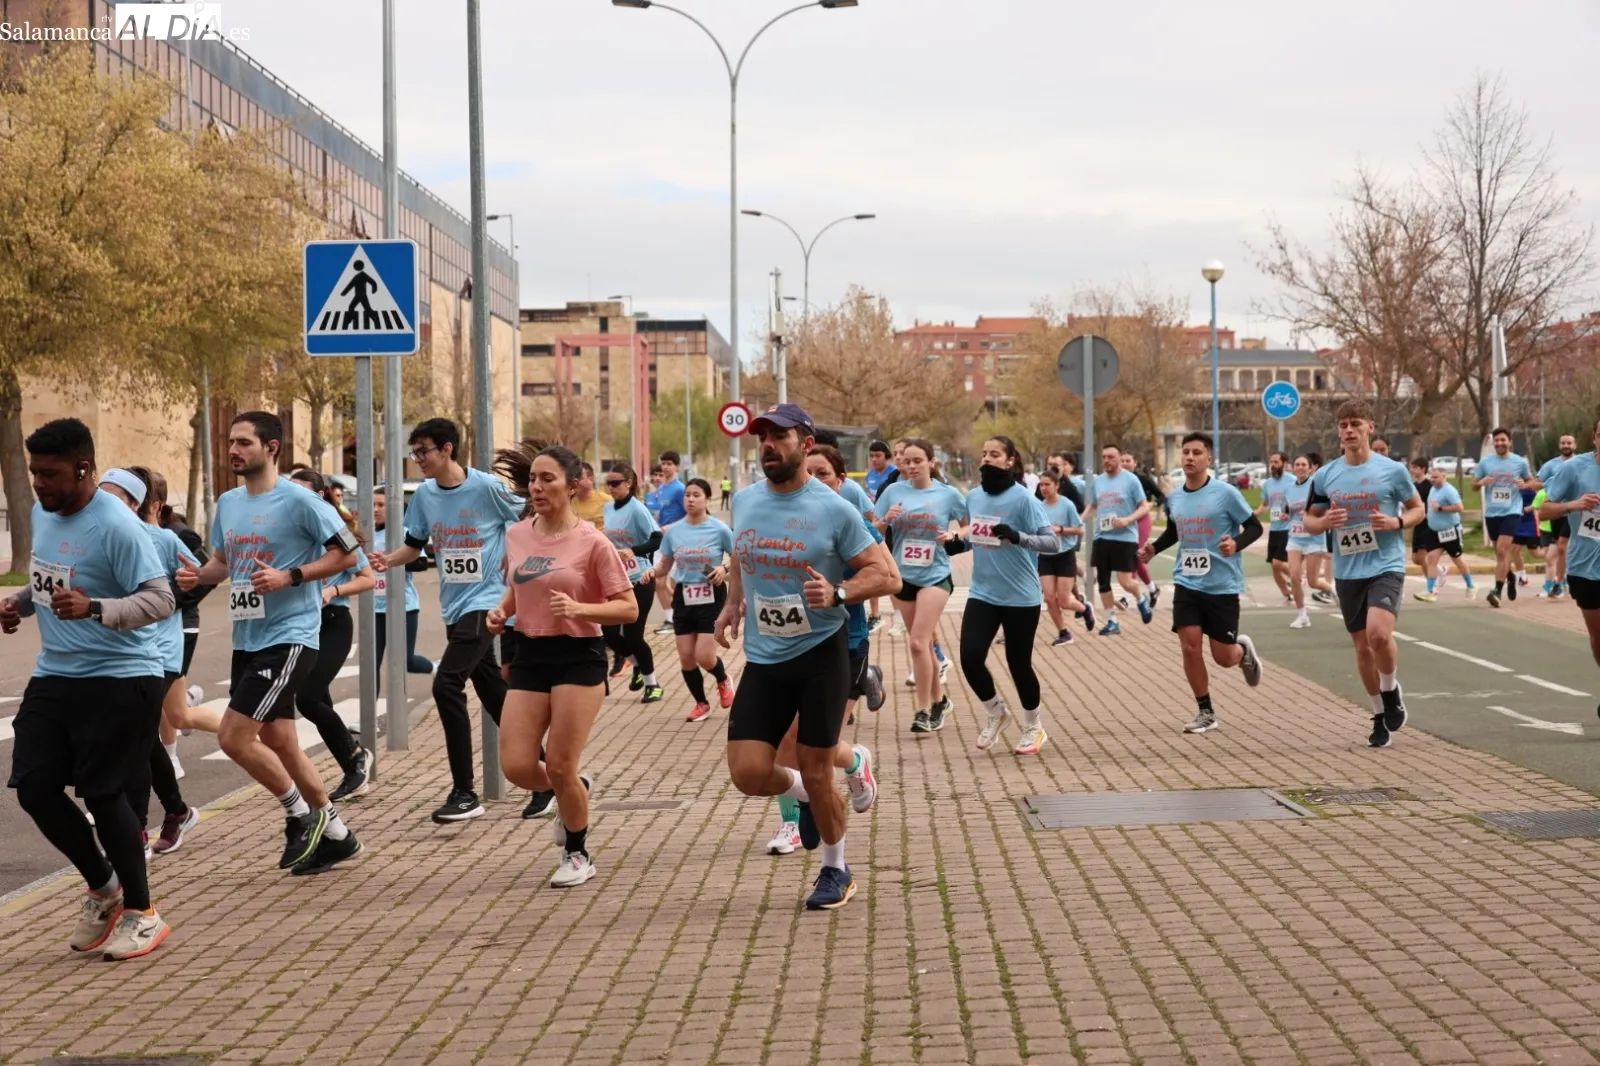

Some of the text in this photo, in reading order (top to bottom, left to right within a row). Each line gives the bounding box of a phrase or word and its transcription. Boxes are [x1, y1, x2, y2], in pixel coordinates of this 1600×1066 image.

[726, 414, 744, 426] 30
[757, 536, 807, 552] contra
[1341, 531, 1373, 547] 413
[757, 553, 771, 567] el
[904, 546, 931, 560] 251
[444, 558, 478, 574] 350
[521, 556, 556, 571] NIKE
[1184, 556, 1208, 569] 412
[230, 590, 261, 610] 346
[686, 586, 712, 599] 175
[759, 606, 803, 627] 434
